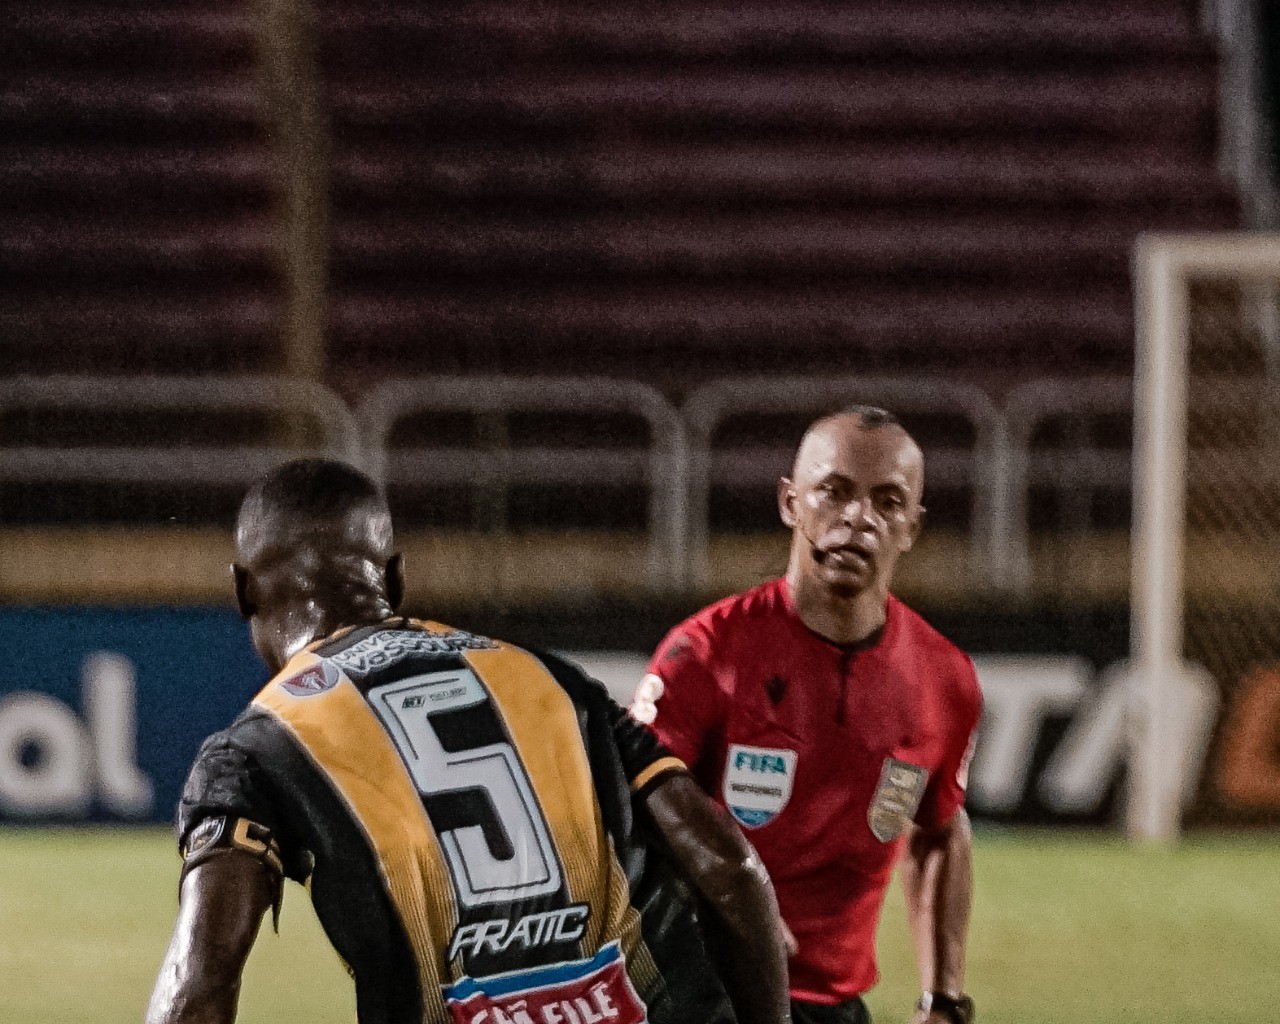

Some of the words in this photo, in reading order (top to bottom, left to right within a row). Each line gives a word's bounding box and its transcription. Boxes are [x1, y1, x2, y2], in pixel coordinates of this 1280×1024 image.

[368, 669, 561, 908] 5
[734, 751, 788, 774] FIFA
[448, 904, 589, 962] PRATIC
